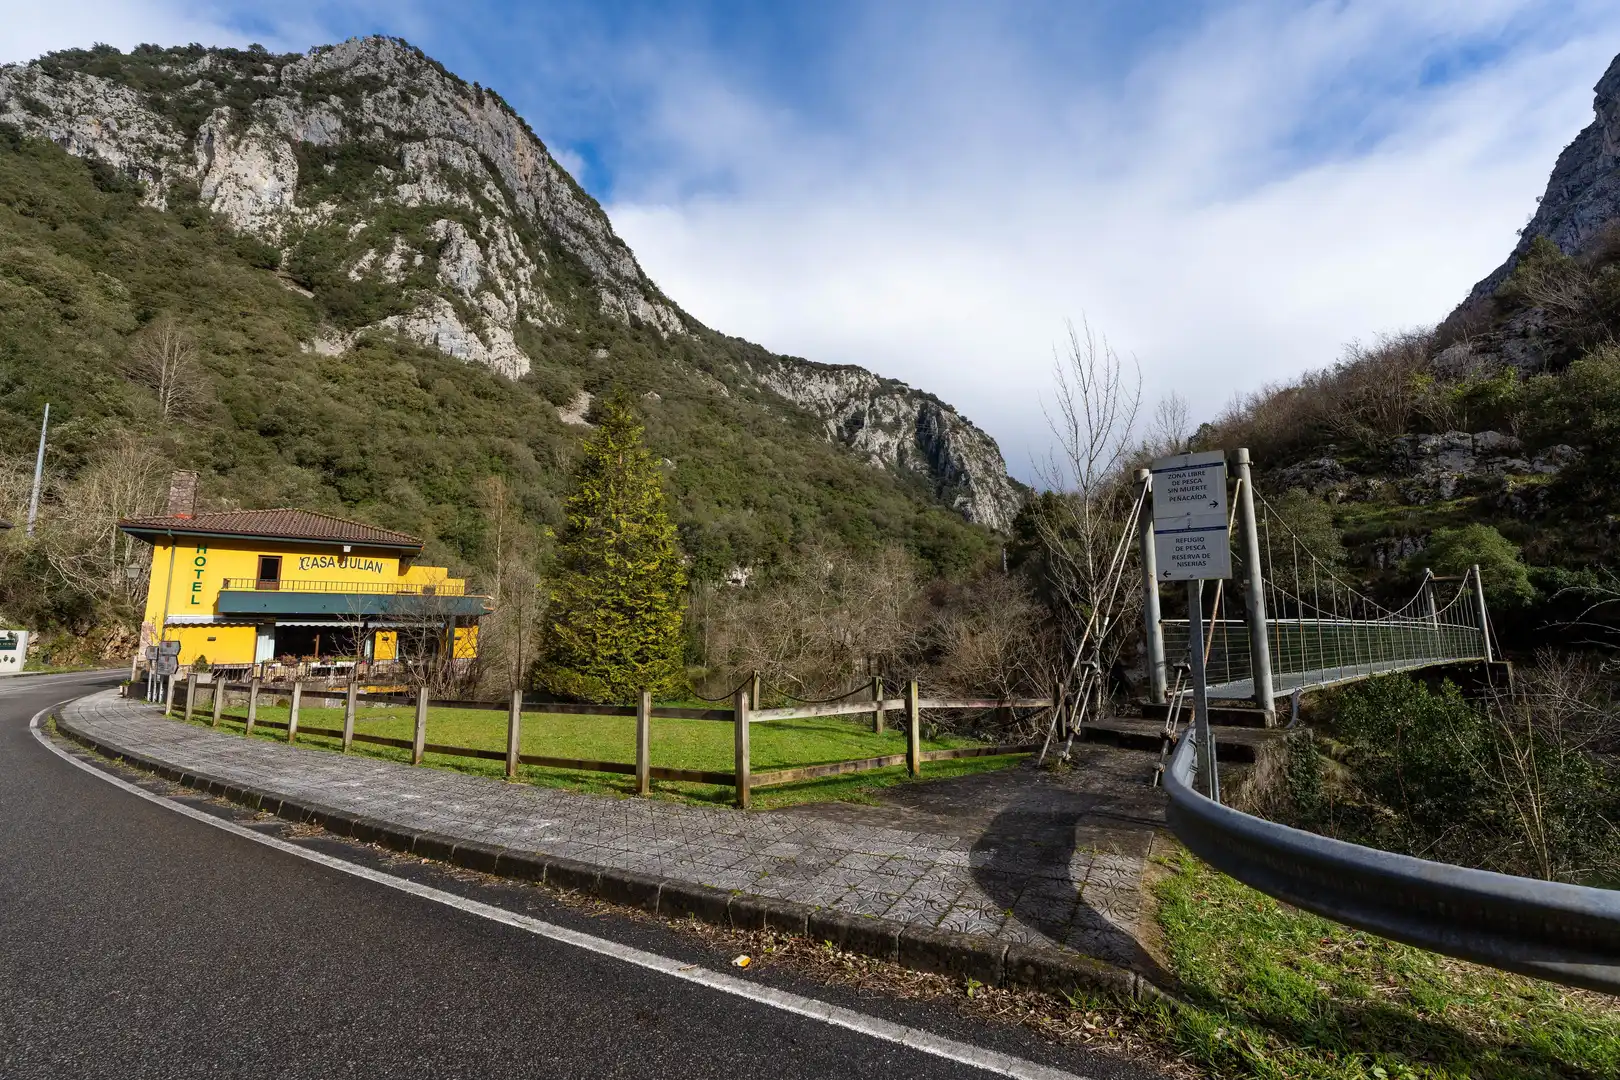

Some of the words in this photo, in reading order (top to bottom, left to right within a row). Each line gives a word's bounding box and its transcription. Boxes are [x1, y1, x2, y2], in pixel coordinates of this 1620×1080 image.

[191, 543, 207, 604] HOTEL
[299, 556, 335, 570] CASA
[339, 556, 383, 573] JULIAN
